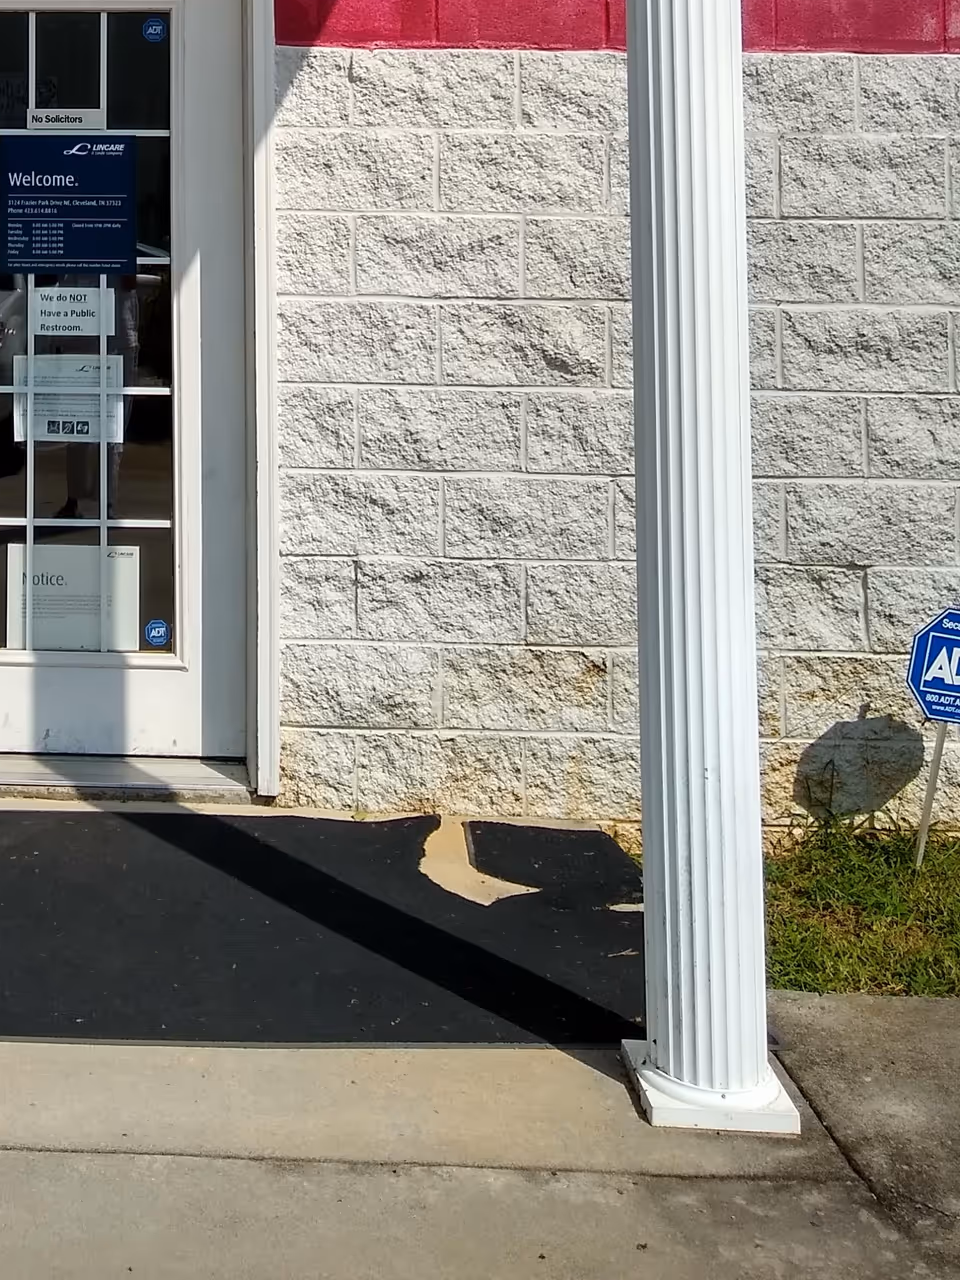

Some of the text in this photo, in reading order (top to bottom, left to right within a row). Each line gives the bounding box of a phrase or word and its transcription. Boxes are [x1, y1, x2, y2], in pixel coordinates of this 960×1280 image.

[146, 26, 163, 34] ADT
[31, 115, 83, 123] No Solicitors
[8, 171, 79, 187] Welcome.
[40, 293, 88, 303] We do NOT
[70, 309, 96, 317] Public
[942, 618, 960, 631] Sec
[150, 628, 166, 637] ADT
